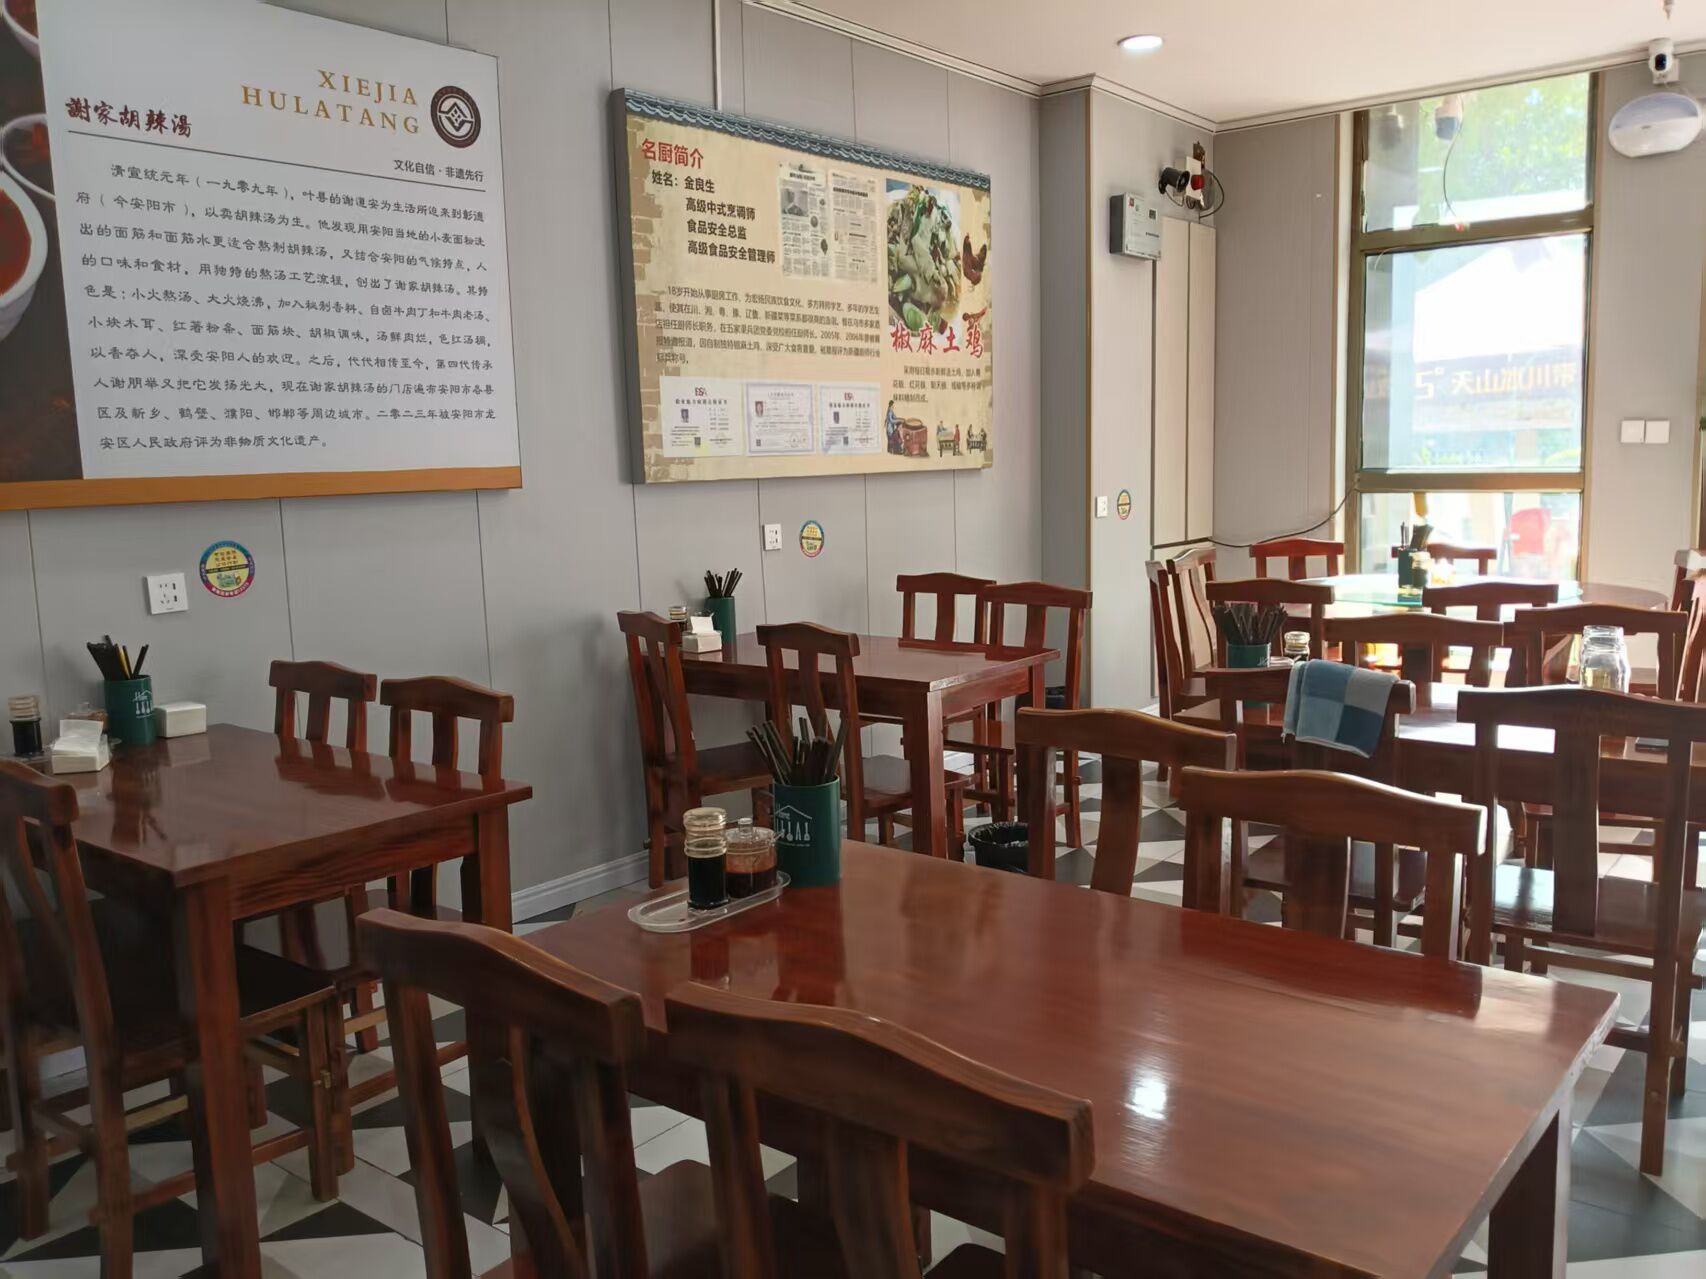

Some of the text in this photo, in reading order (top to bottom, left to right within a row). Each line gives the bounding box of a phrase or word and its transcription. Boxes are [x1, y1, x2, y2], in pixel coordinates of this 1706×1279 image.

[318, 69, 418, 105] XIEJIA
[241, 85, 420, 135] HULATANG
[641, 138, 704, 169] 名厨简介
[686, 197, 756, 221] 高级中式烹调师
[687, 218, 748, 240] 食品安全总监
[688, 239, 776, 264] 高级食品安全管理师
[890, 322, 983, 358] 椒麻土鸡
